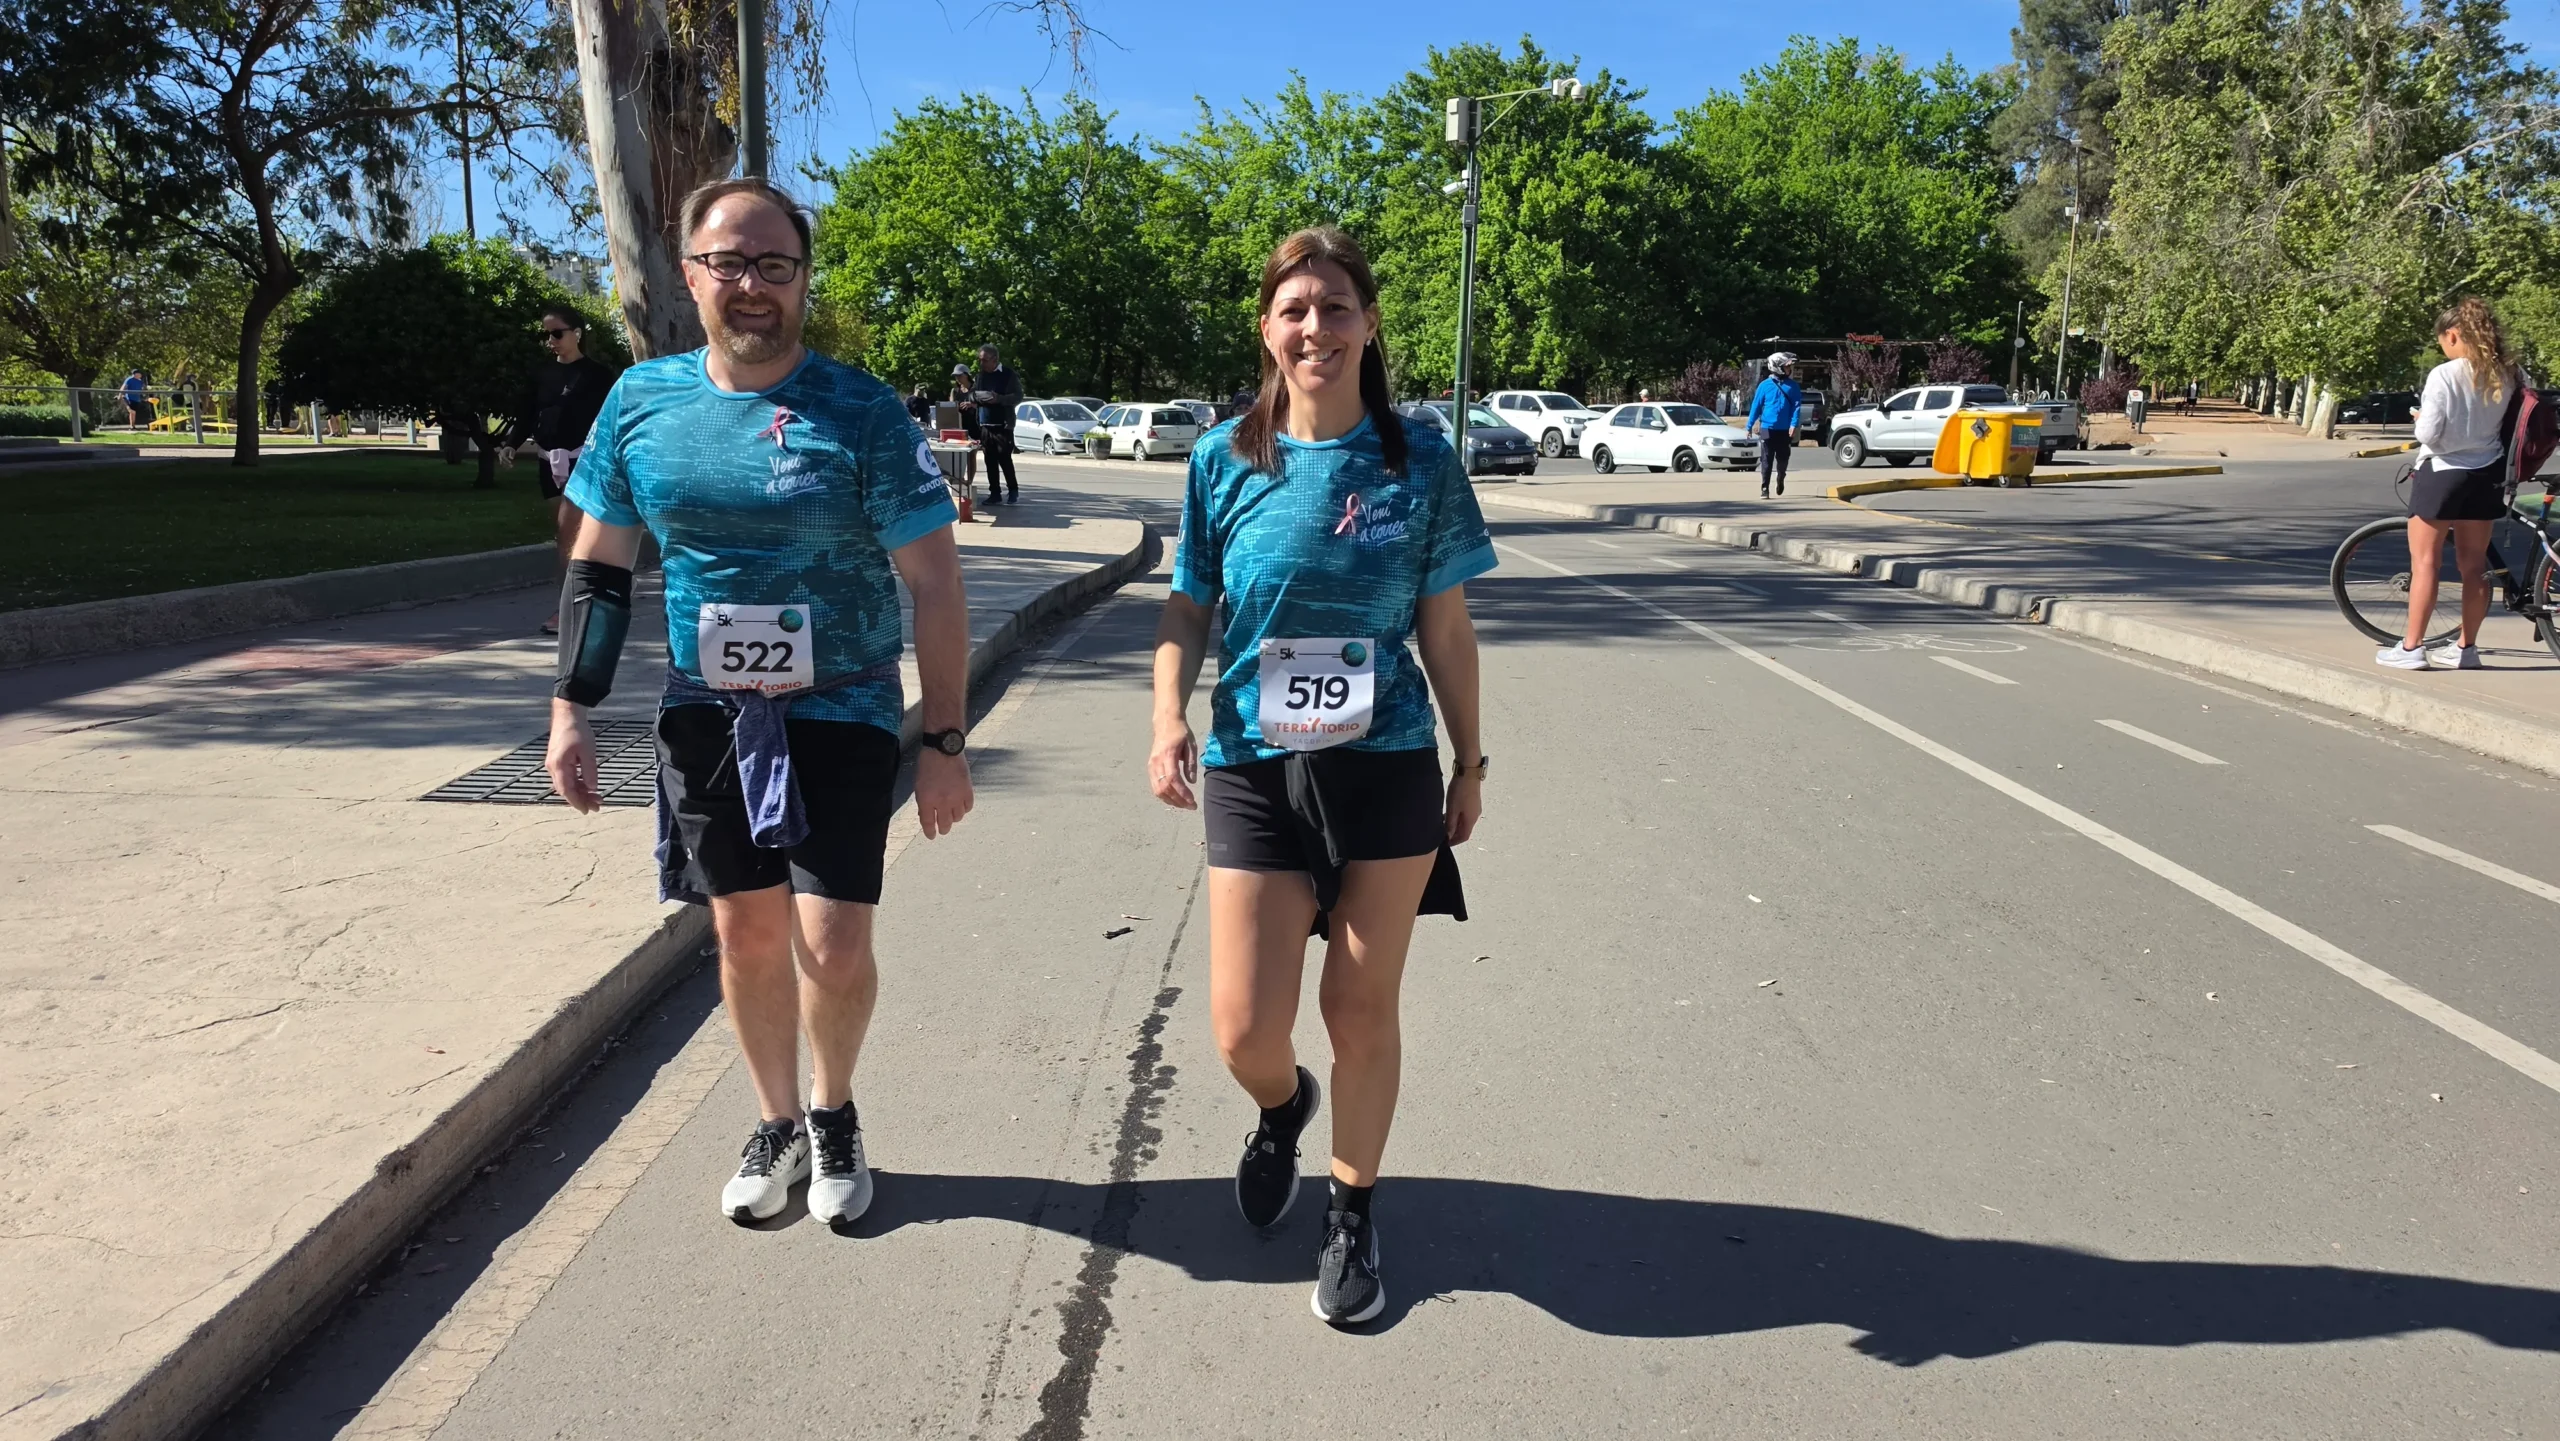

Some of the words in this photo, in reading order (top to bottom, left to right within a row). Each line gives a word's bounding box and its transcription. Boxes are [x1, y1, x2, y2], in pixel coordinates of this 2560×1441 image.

[1361, 498, 1391, 524] Vení
[1370, 520, 1406, 539] correr
[717, 614, 734, 627] 5k
[721, 641, 794, 673] 522
[1280, 648, 1296, 661] 5k
[1284, 675, 1350, 711] 519
[1274, 717, 1360, 734] TERRITORIO
